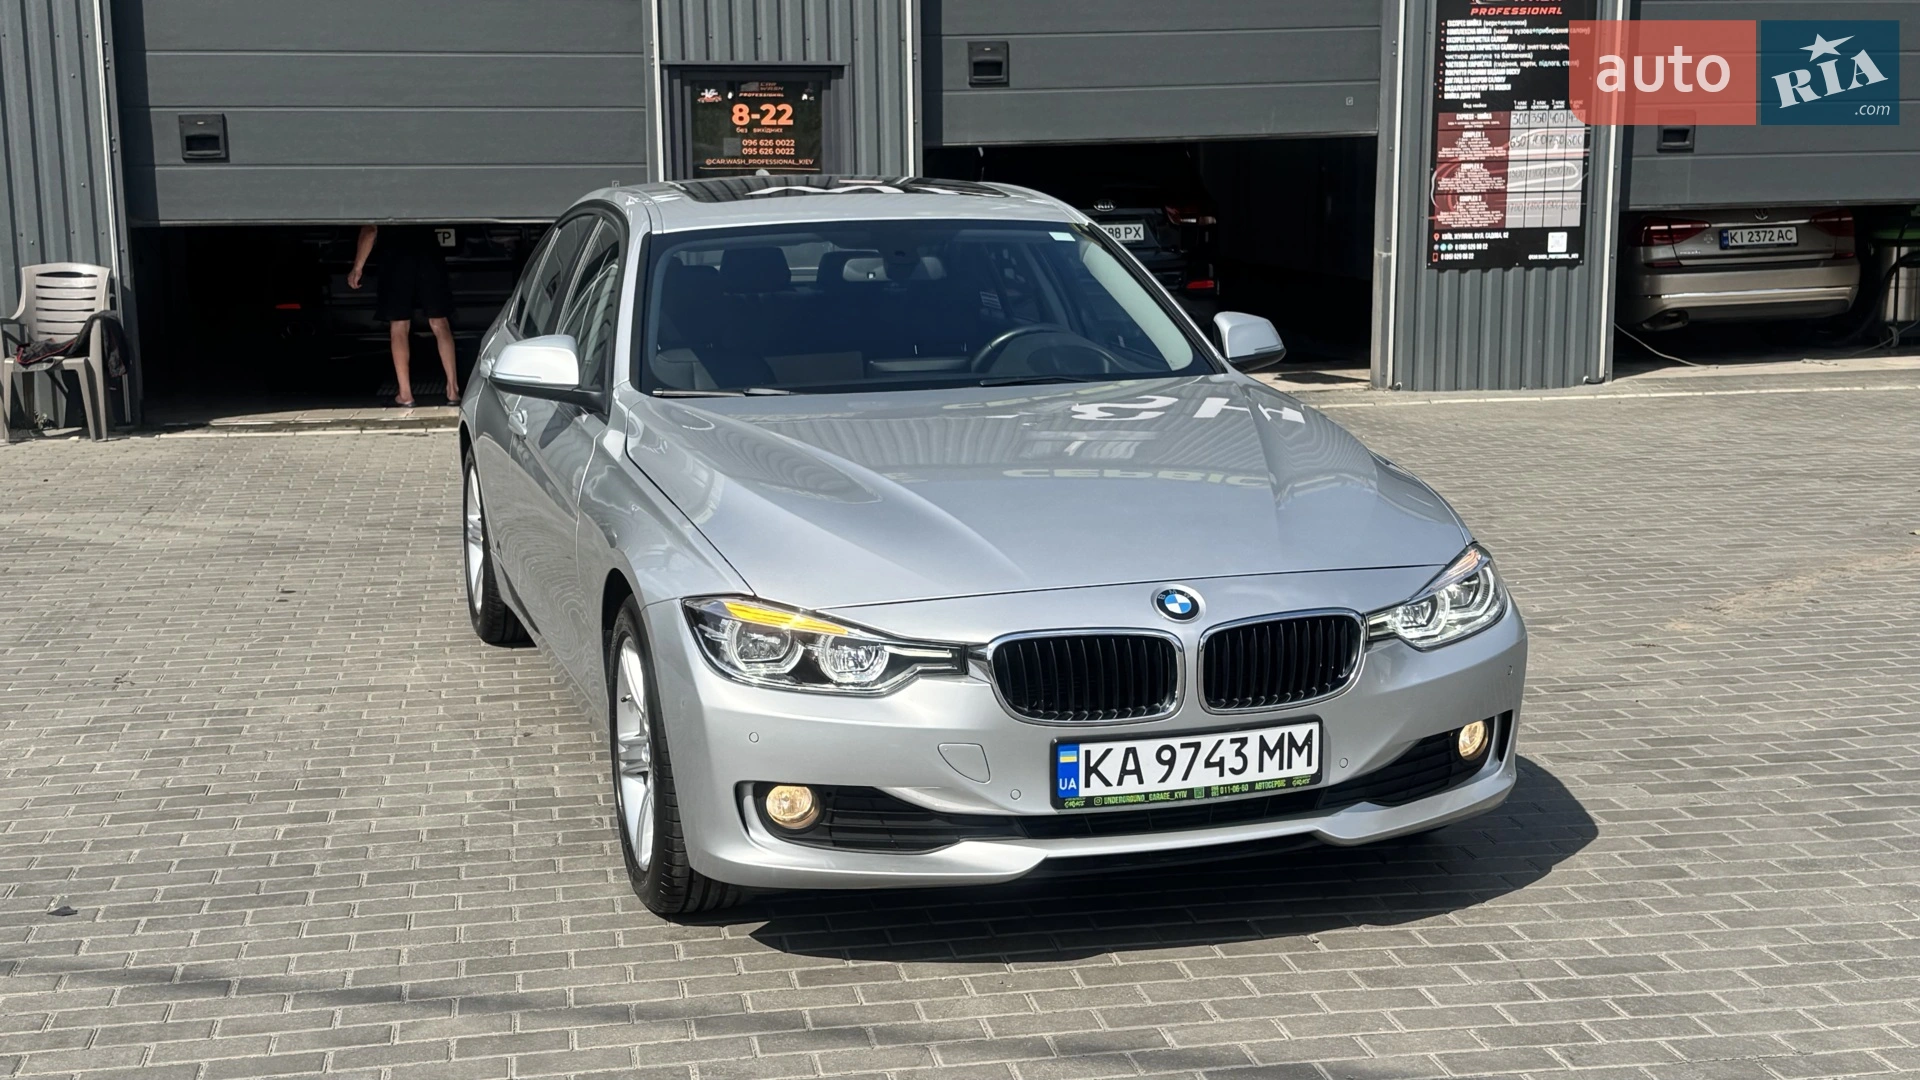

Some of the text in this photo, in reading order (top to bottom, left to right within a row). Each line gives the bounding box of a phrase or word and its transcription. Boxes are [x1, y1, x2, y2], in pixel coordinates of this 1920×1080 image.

[1470, 6, 1563, 16] PROFESSIONAL
[732, 104, 794, 125] 8-22
[1512, 113, 1528, 125] 300
[1532, 112, 1547, 122] 350
[1550, 113, 1564, 124] 400
[1510, 135, 1526, 148] 650
[1104, 227, 1141, 239] 88 PX
[1730, 229, 1793, 244] KI 2372 AC
[1158, 588, 1192, 600] BMW
[1084, 728, 1314, 789] KA 9743 MM
[1059, 778, 1077, 790] UA
[1255, 780, 1286, 790] АВТОСЕРВІС
[1104, 790, 1188, 805] UNDERGROUND_GARAGE_KYIV
